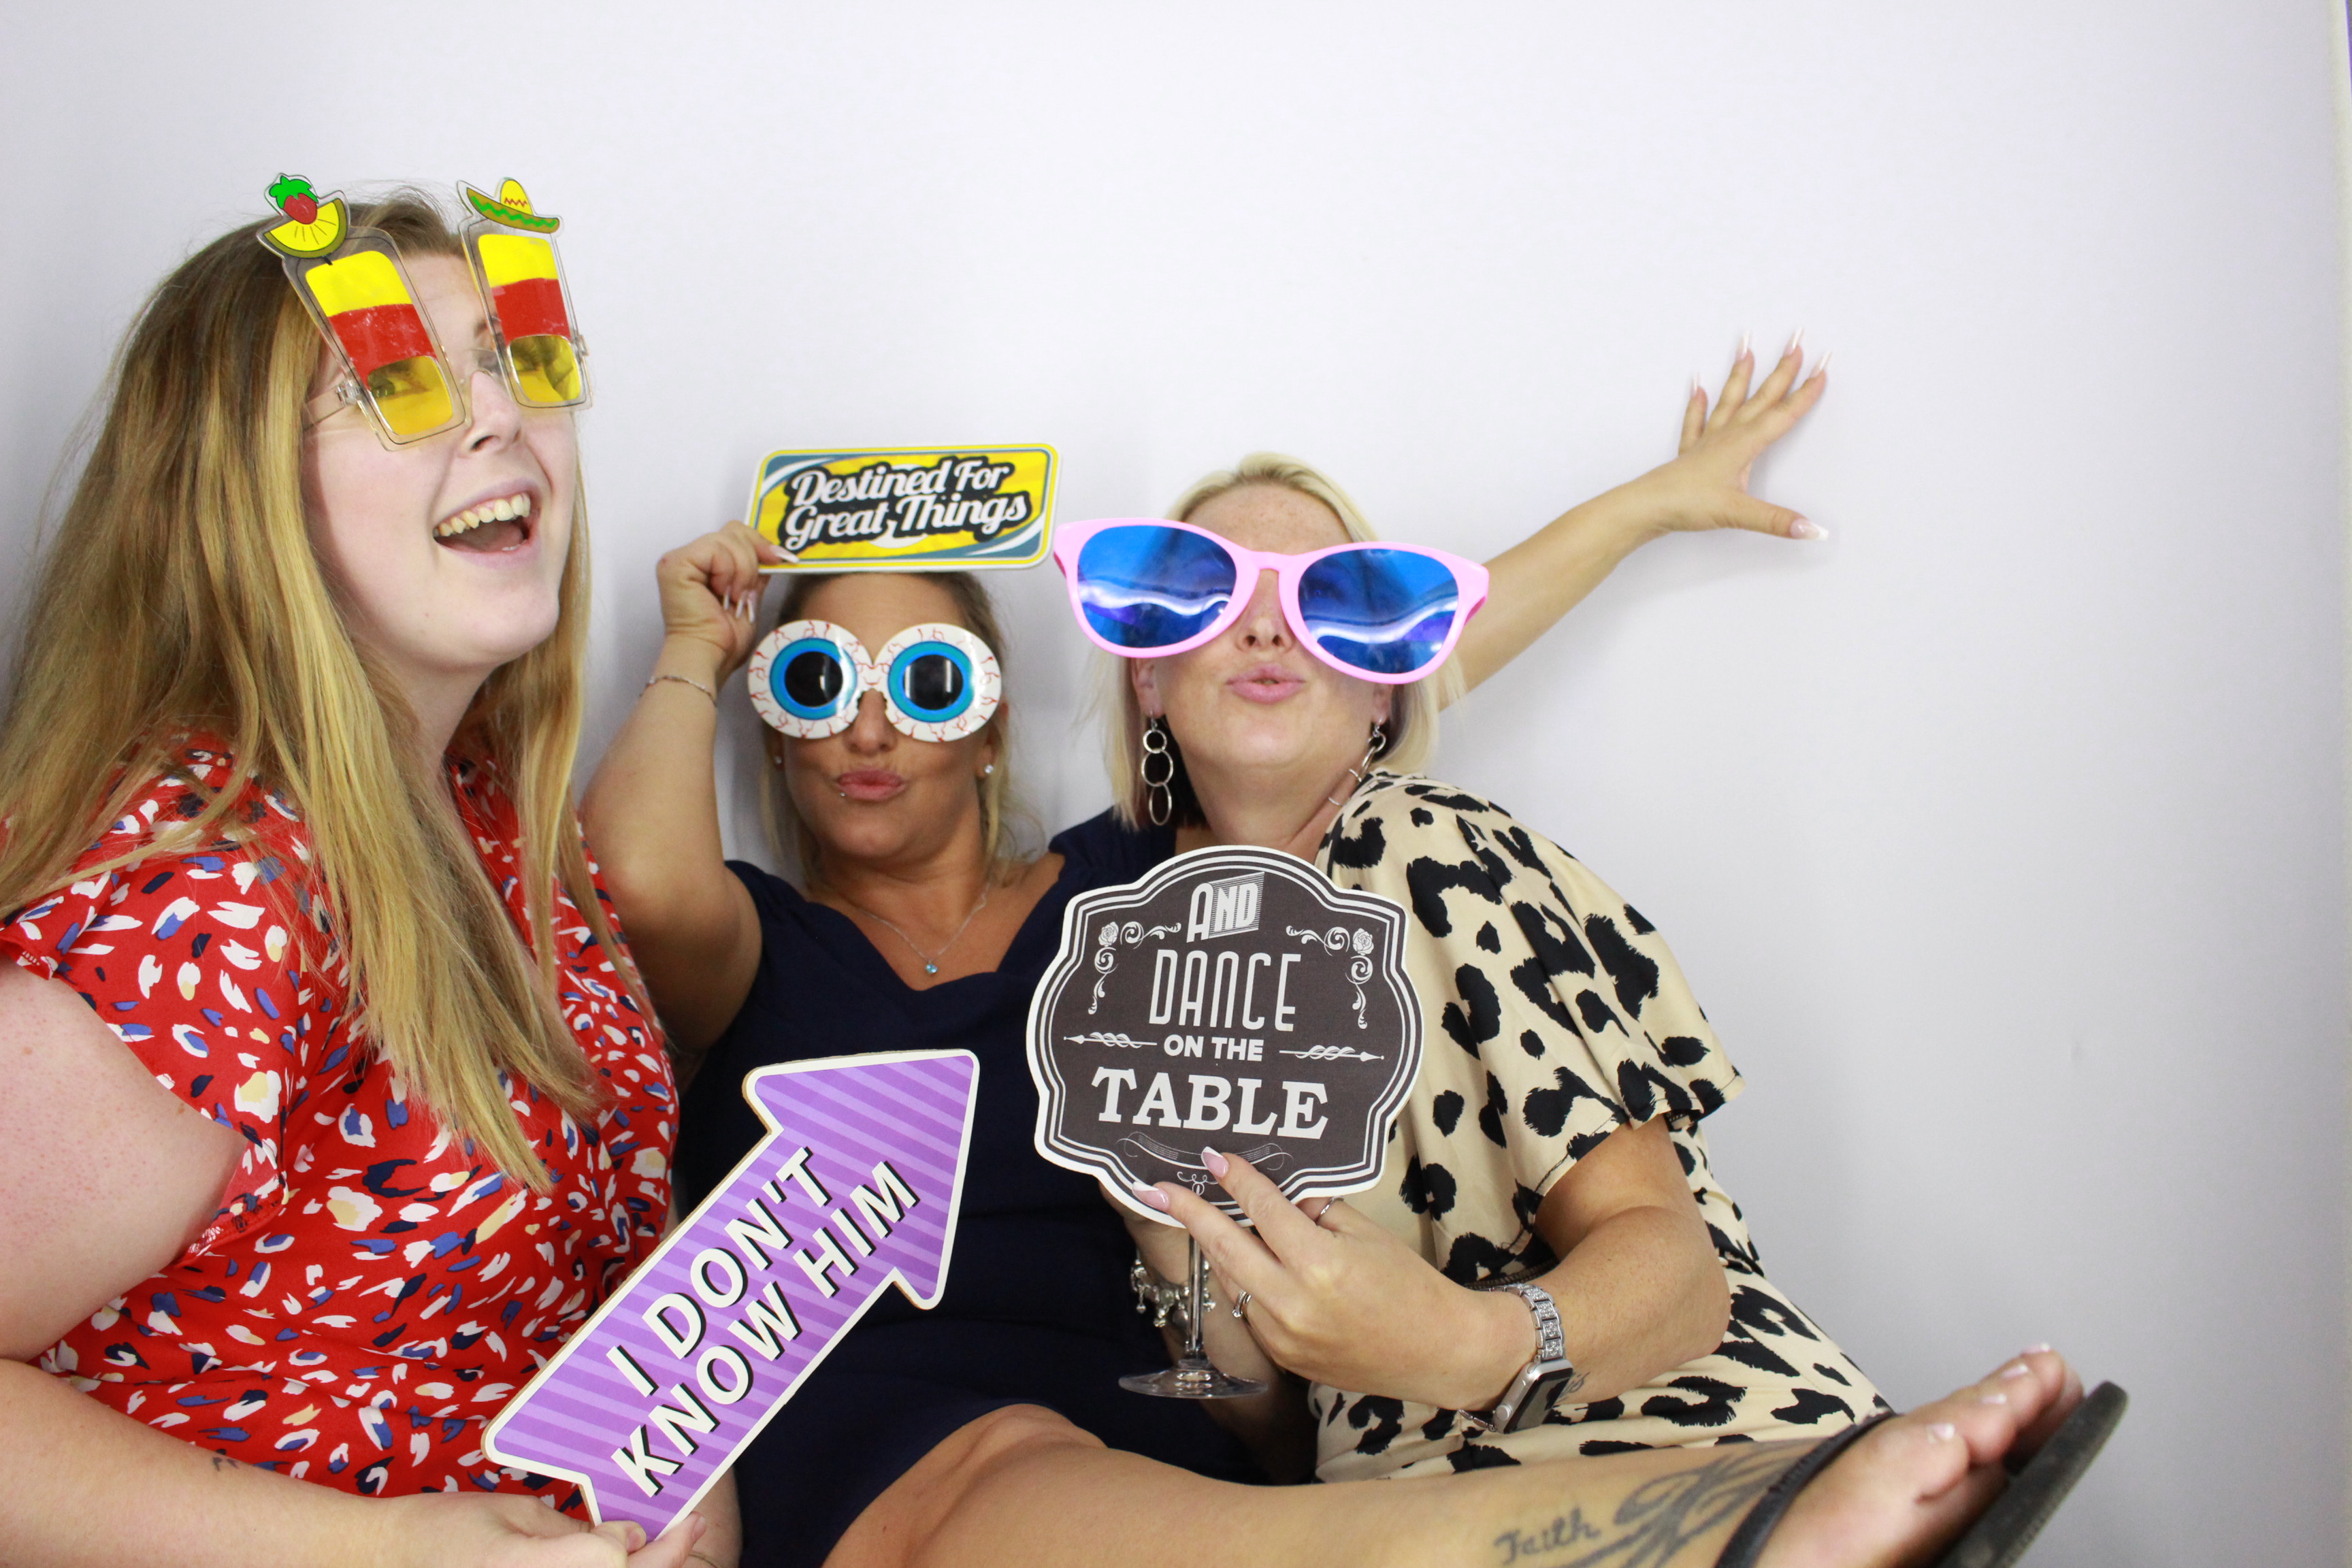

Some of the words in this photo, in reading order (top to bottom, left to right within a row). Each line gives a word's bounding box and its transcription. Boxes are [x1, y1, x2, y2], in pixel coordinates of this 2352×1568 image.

[792, 461, 949, 504] Destined
[956, 461, 1009, 489] For
[786, 502, 890, 549] Great
[897, 495, 1026, 533] Things
[1187, 878, 1262, 942] AND
[1149, 949, 1301, 1032] DANCE
[1163, 1034, 1204, 1058] ON
[1207, 1036, 1264, 1062] THE
[1091, 1066, 1328, 1140] TABLE
[606, 1345, 659, 1398] I
[642, 1146, 832, 1360] DON'T
[610, 1282, 802, 1498] KNOW
[793, 1161, 919, 1299] HIM
